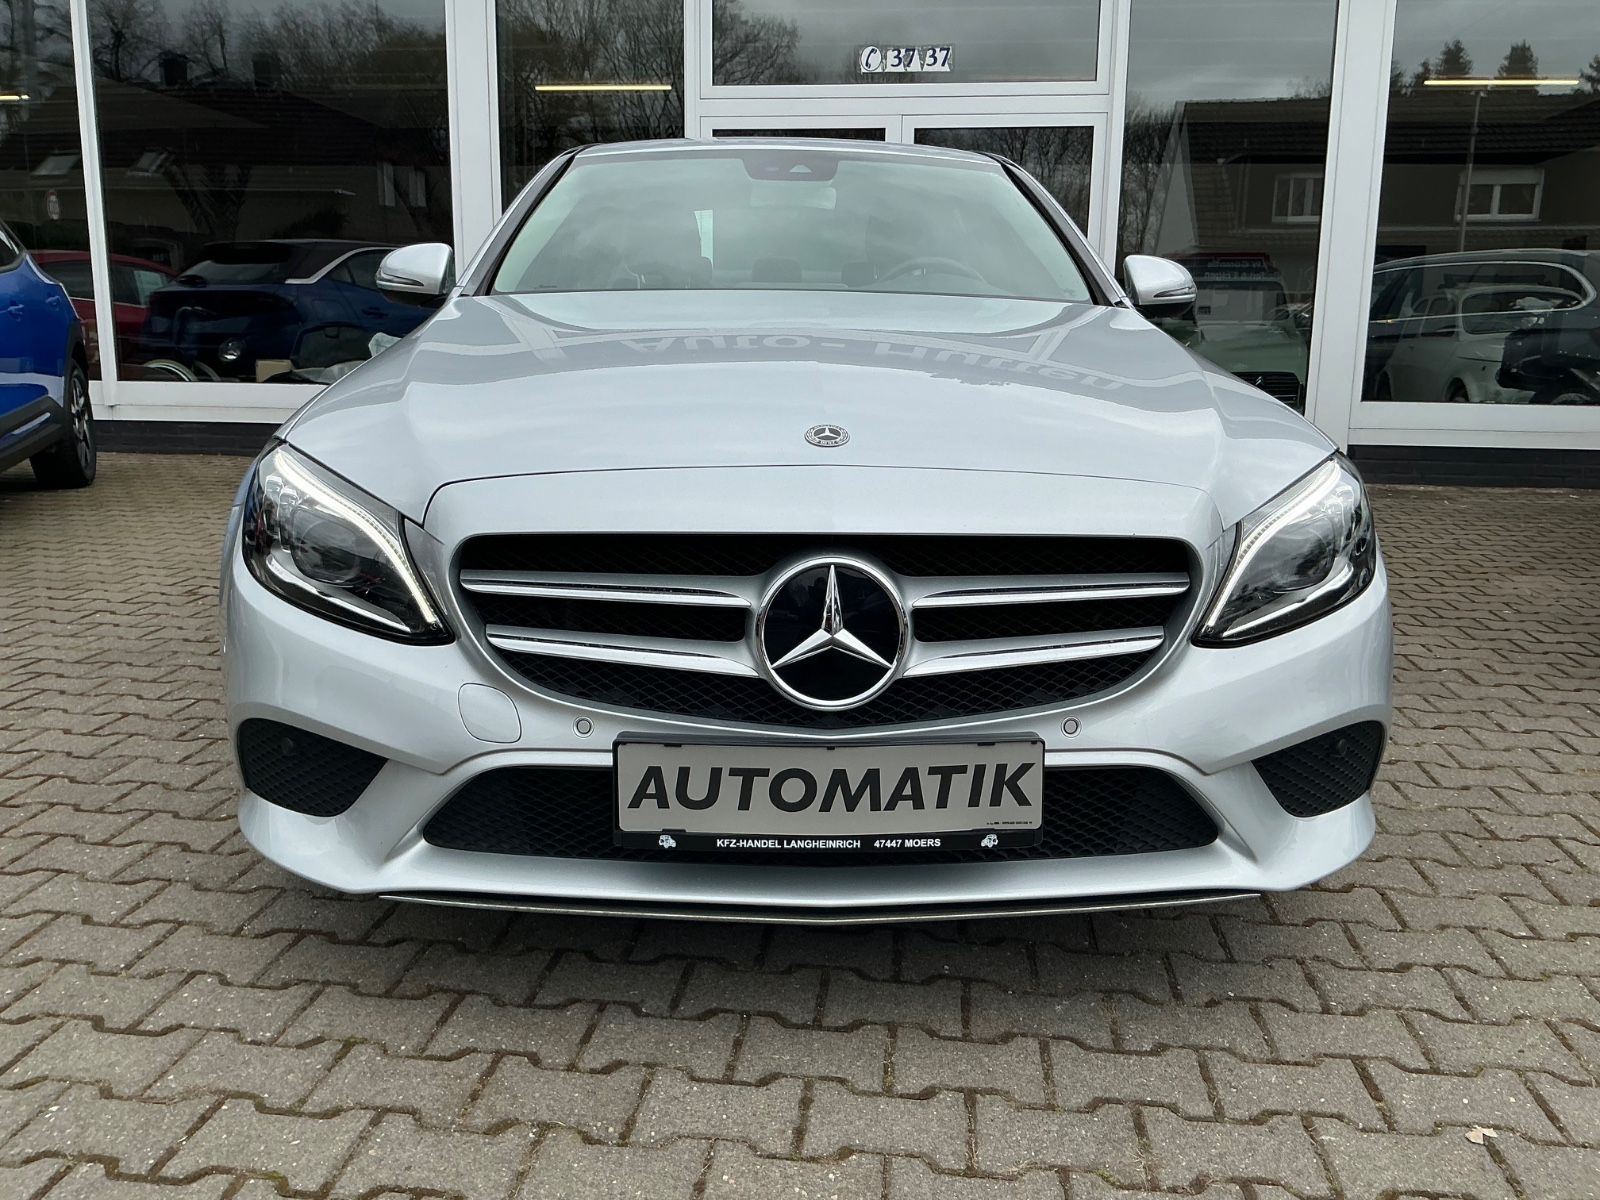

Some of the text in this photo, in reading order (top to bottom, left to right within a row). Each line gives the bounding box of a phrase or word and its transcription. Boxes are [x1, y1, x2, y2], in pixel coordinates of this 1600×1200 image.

[890, 47, 951, 68] 37 37
[627, 763, 1037, 813] AUTOMATIK
[716, 838, 942, 849] KFZ-HANDEL LANGHEINRICH 47447 MOERS
